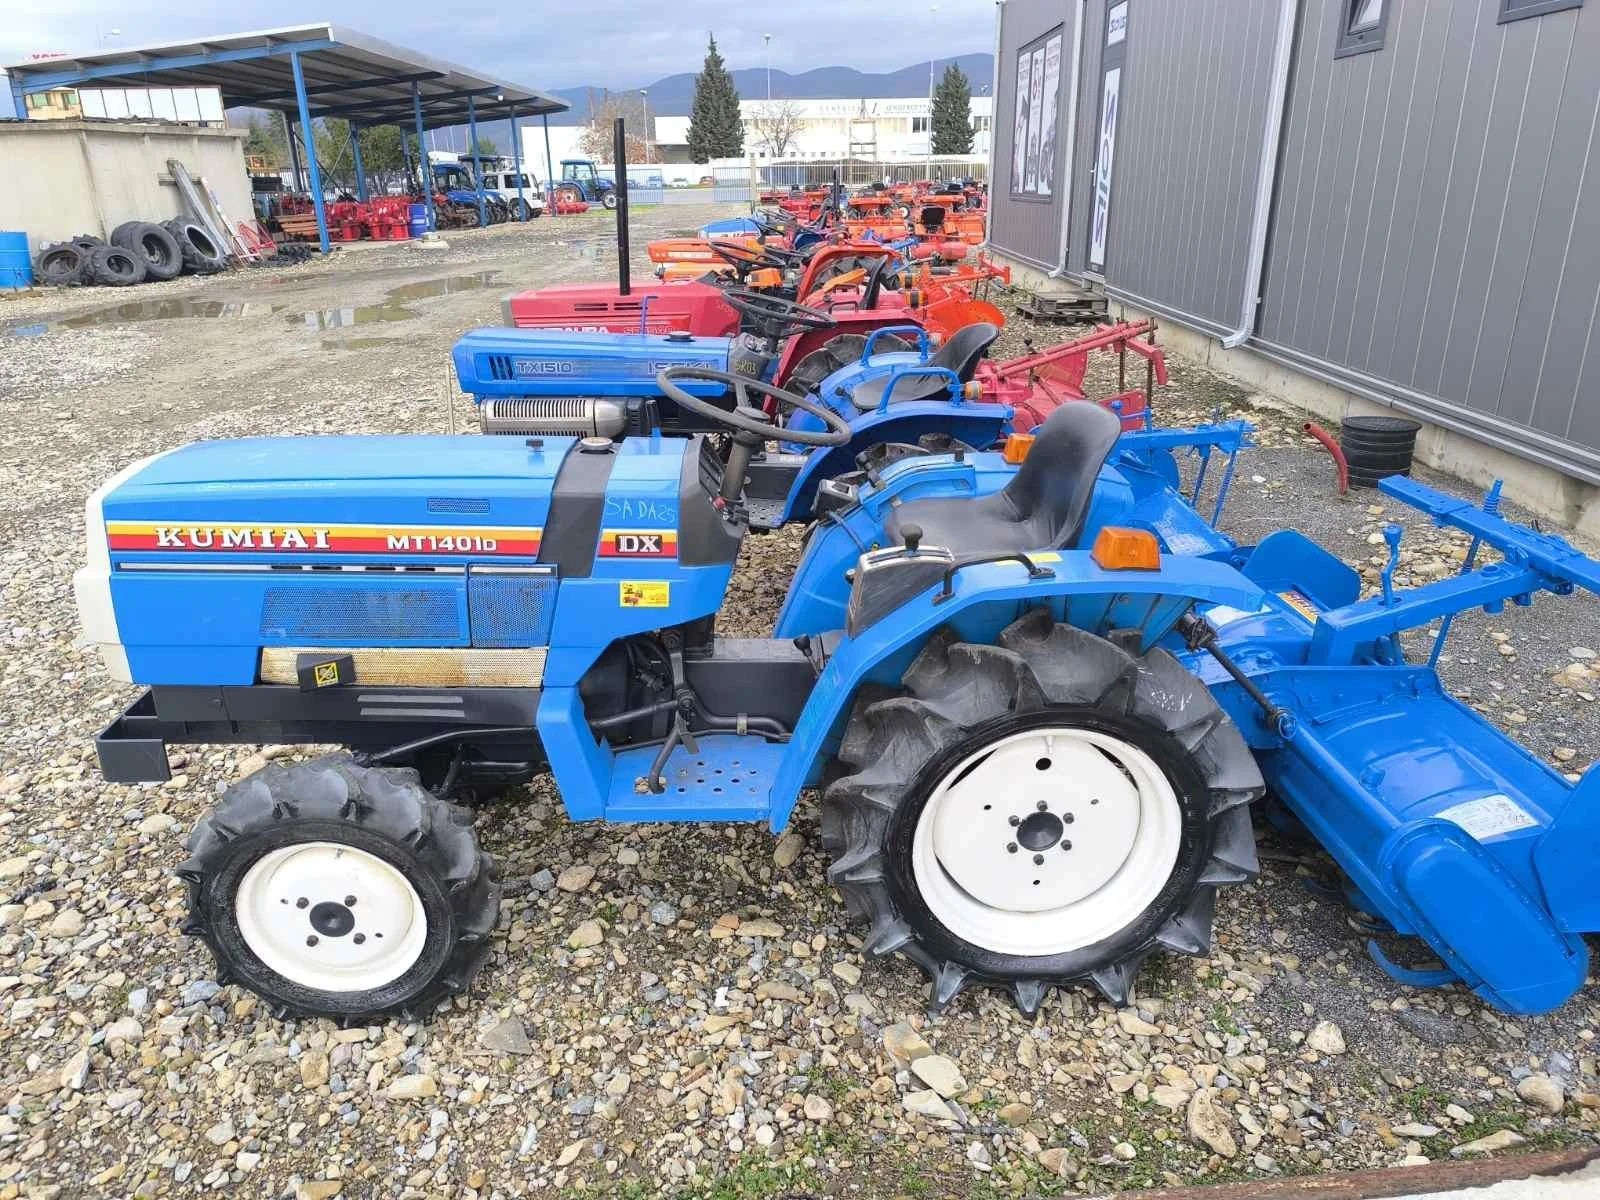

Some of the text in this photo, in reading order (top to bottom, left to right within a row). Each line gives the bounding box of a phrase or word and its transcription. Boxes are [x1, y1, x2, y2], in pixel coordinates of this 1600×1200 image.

[515, 361, 574, 375] TX1510
[155, 527, 332, 549] KUMIAI
[386, 534, 498, 551] MT1401D
[618, 535, 661, 553] DX
